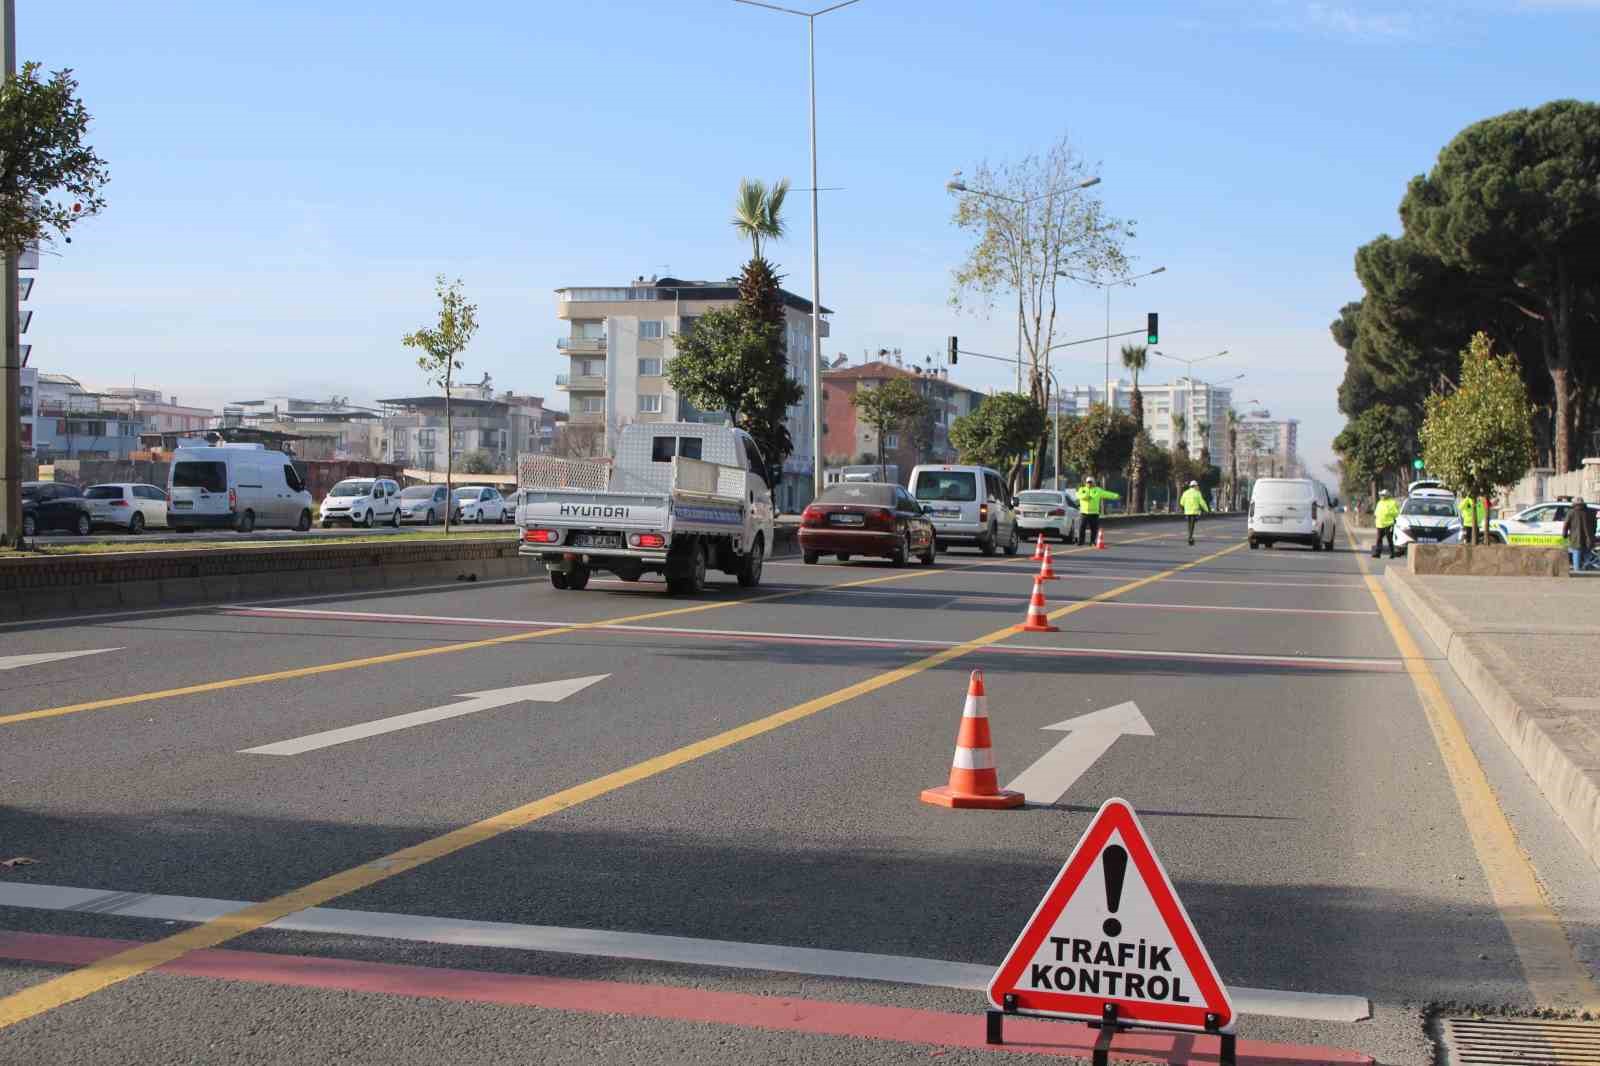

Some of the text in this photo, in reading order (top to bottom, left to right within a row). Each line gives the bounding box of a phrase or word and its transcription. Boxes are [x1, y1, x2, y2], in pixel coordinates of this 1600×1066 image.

[560, 504, 630, 519] HYUNDAI
[1050, 936, 1173, 972] TRAFİK
[1031, 964, 1190, 1003] KONTROL
